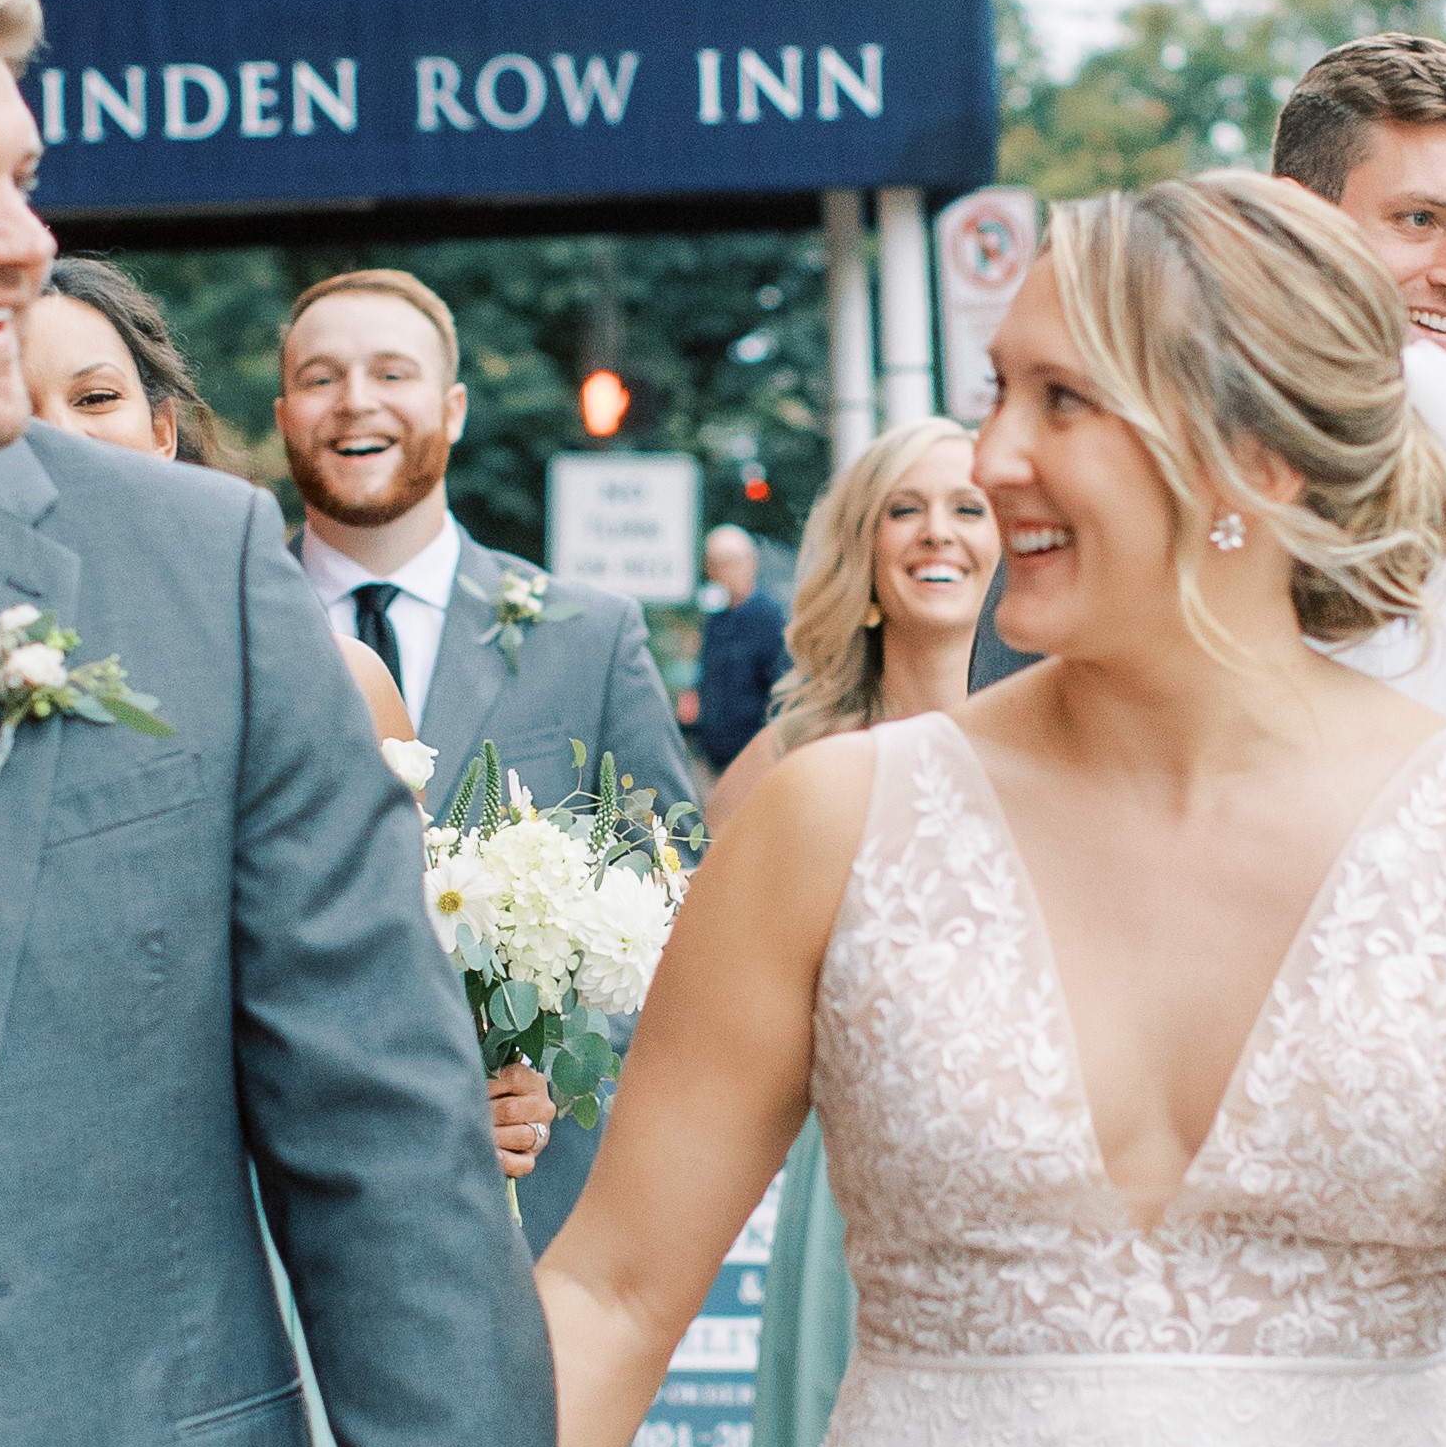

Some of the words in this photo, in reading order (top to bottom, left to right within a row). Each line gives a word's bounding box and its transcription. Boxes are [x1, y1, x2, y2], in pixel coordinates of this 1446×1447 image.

[42, 56, 357, 143] INDEN
[415, 51, 639, 132] ROW
[698, 43, 885, 124] INN
